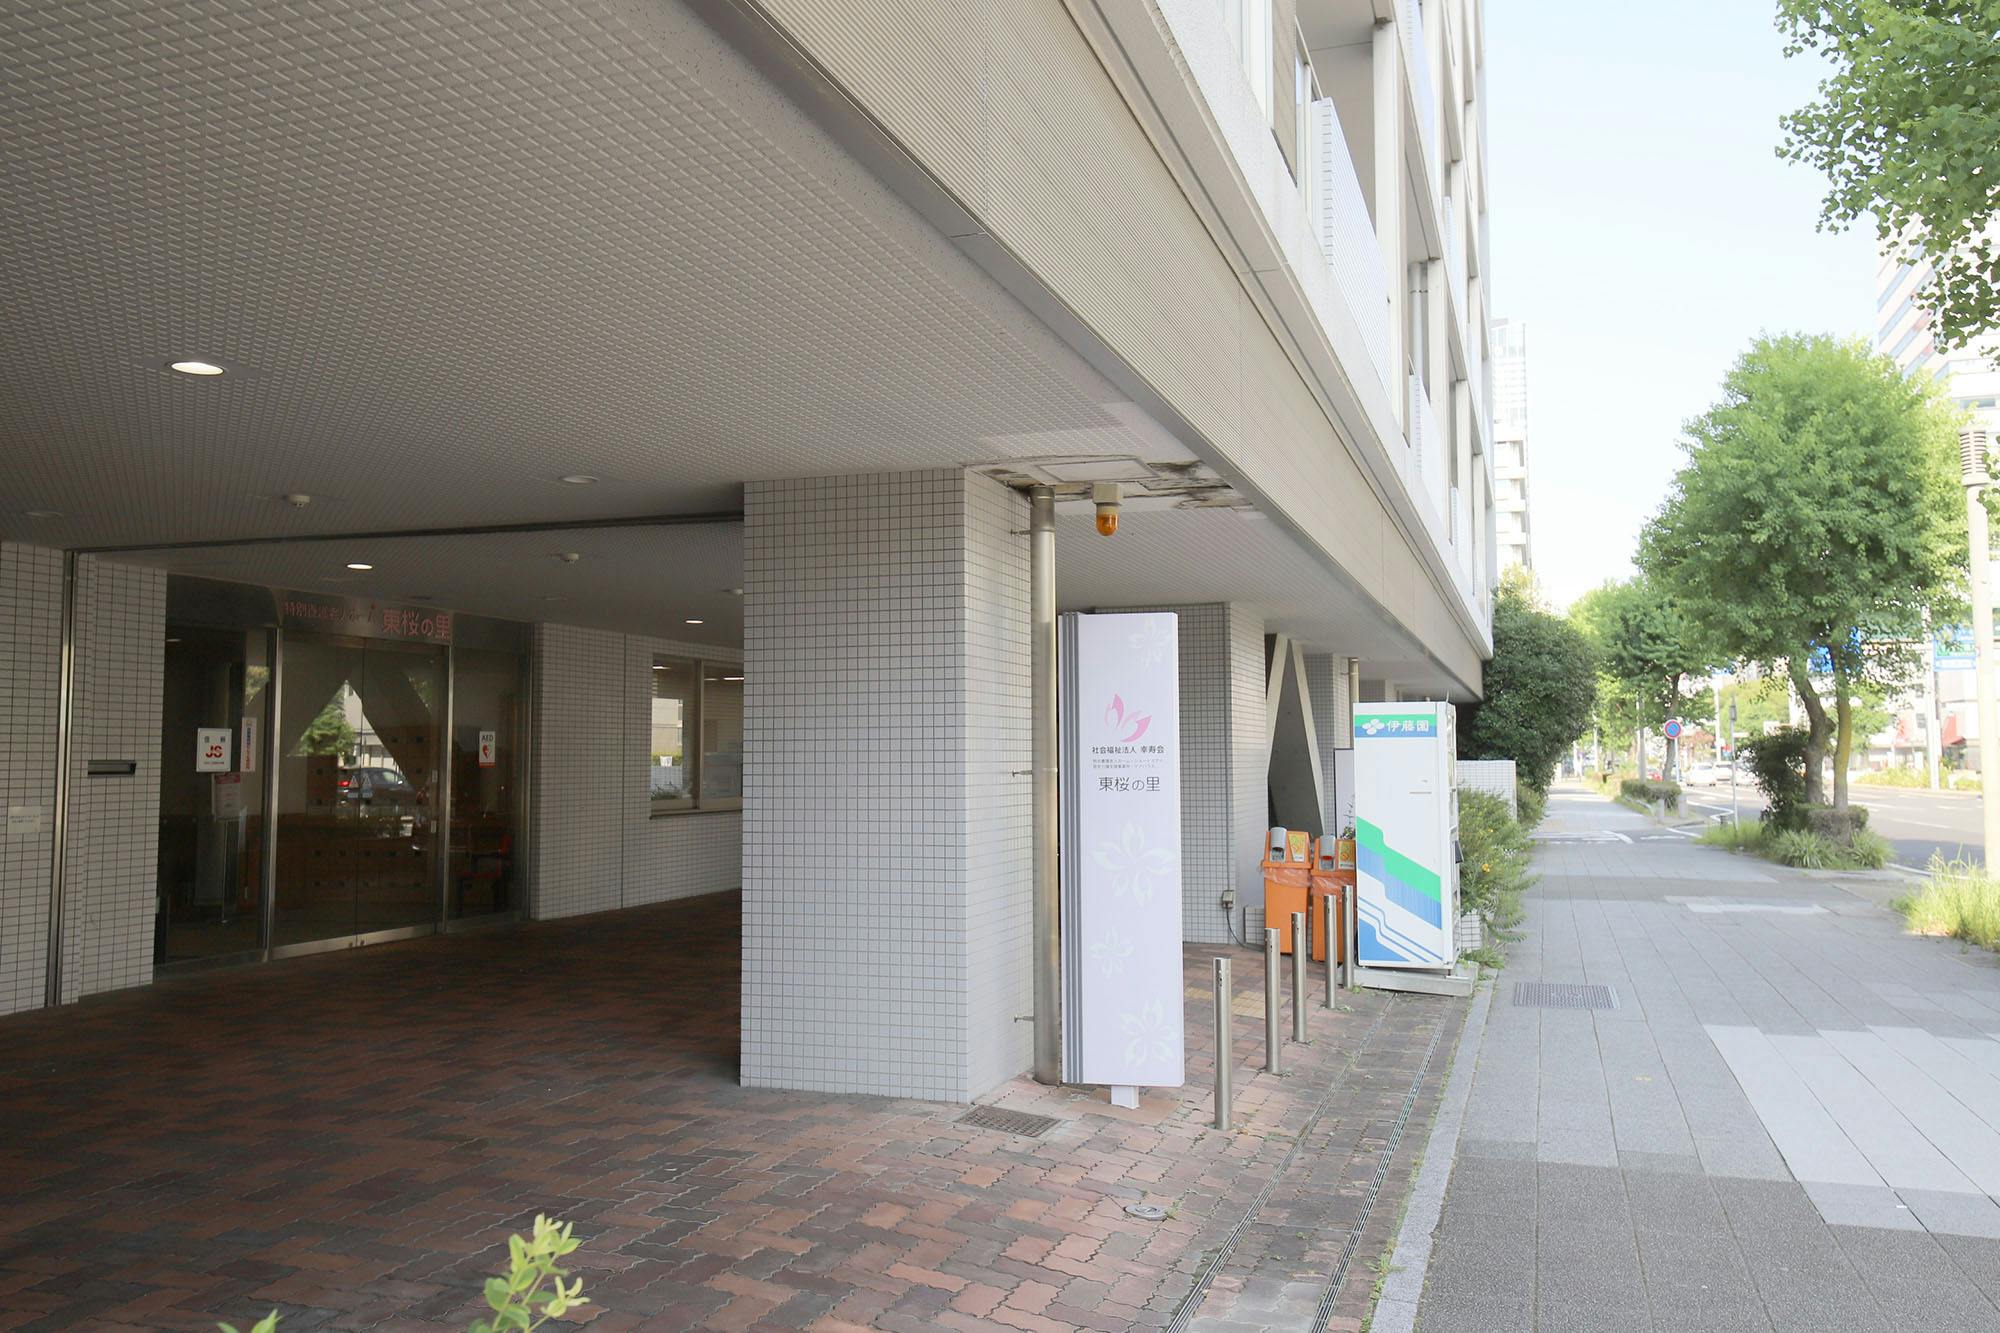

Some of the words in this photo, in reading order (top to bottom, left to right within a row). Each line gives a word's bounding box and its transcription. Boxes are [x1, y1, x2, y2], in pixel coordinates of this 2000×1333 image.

[383, 608, 450, 640] 東桜の里
[1386, 719, 1430, 732] 伊藤園
[1092, 745, 1137, 754] 社会福祉法人
[1098, 776, 1161, 792] 東桜の里
